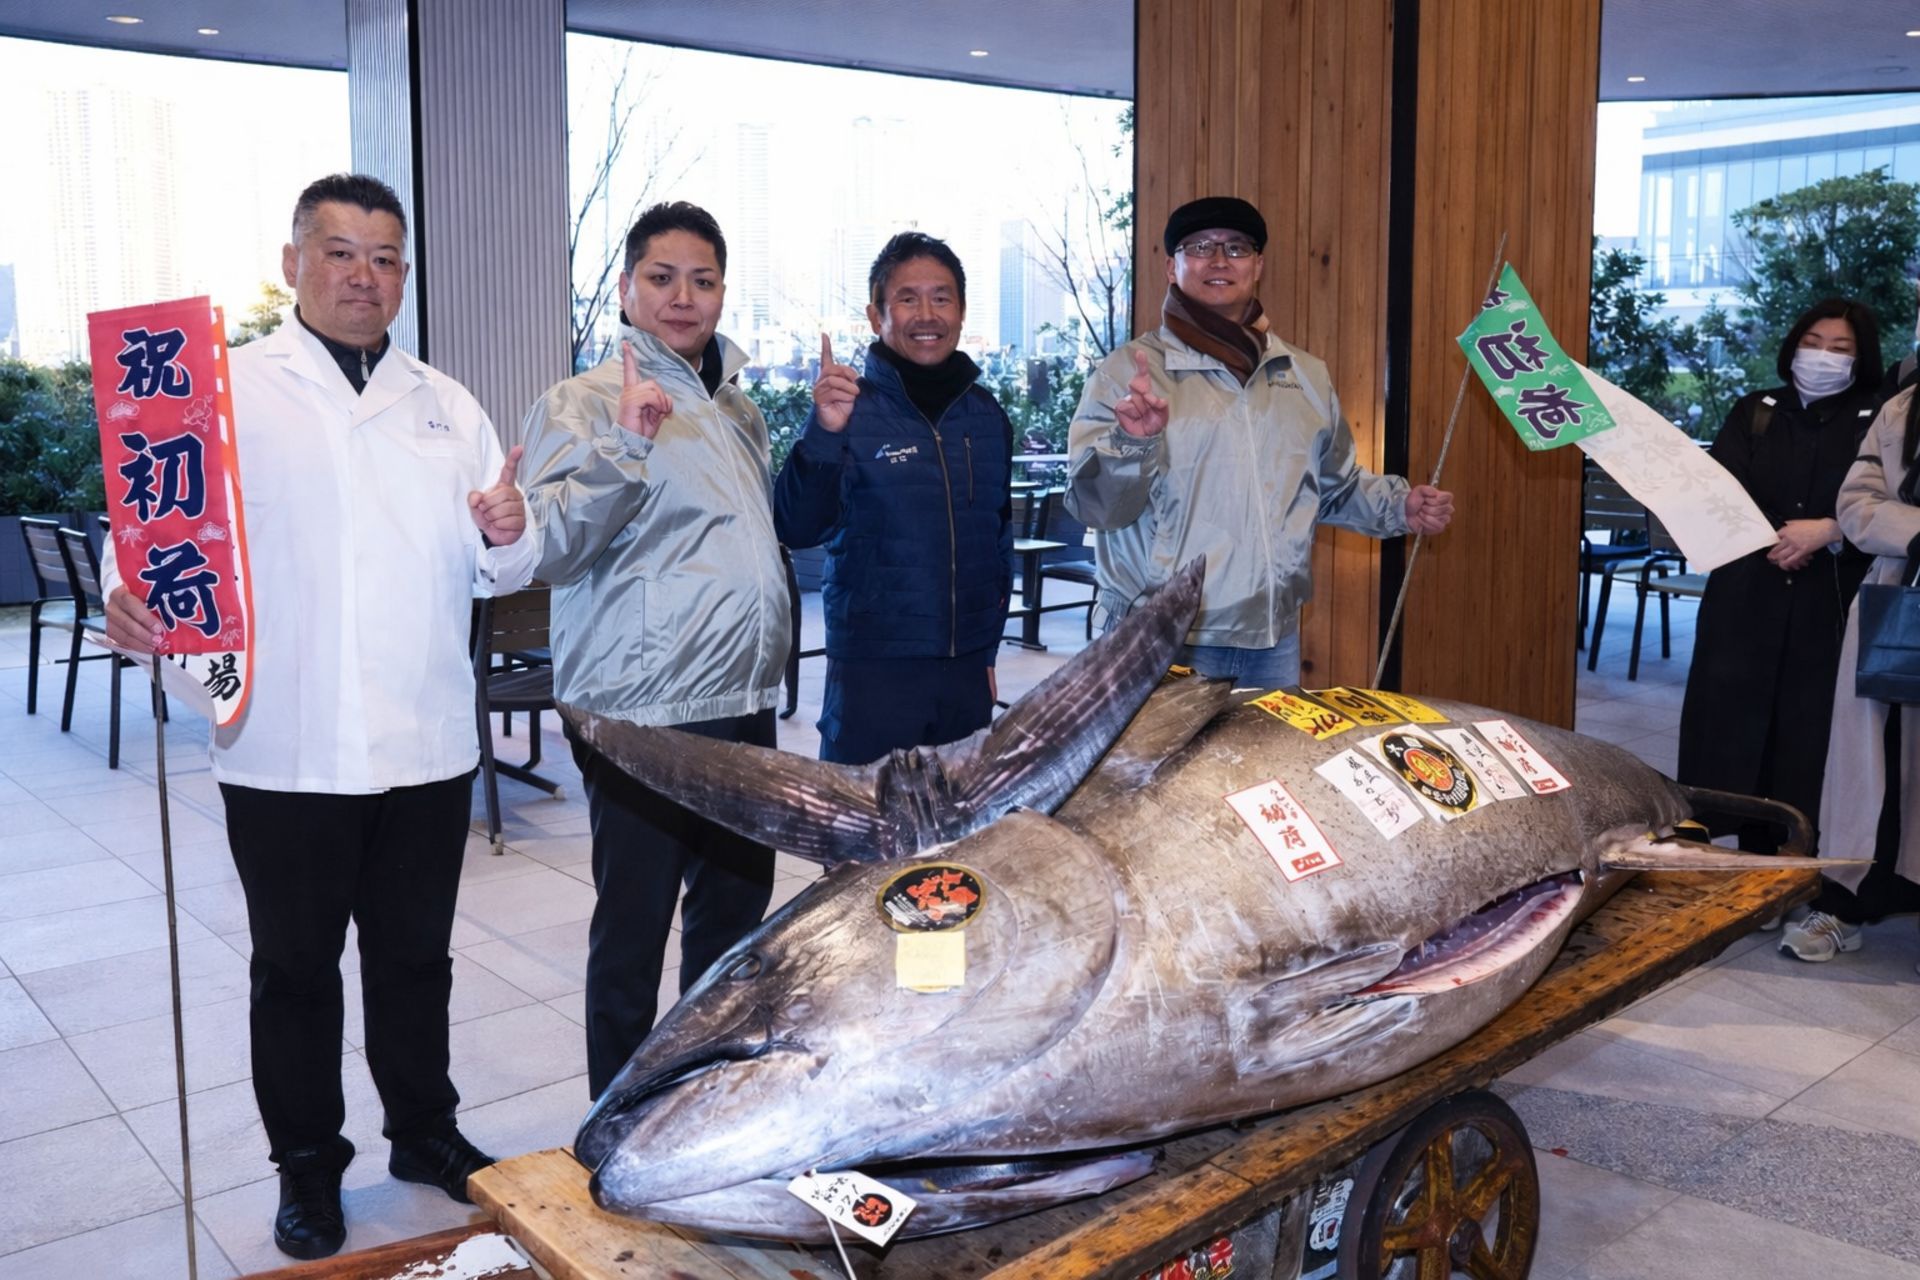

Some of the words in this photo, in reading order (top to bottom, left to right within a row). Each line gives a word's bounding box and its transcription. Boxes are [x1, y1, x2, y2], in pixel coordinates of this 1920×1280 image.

[116, 327, 221, 638] 祝初荷
[203, 652, 242, 702] 場
